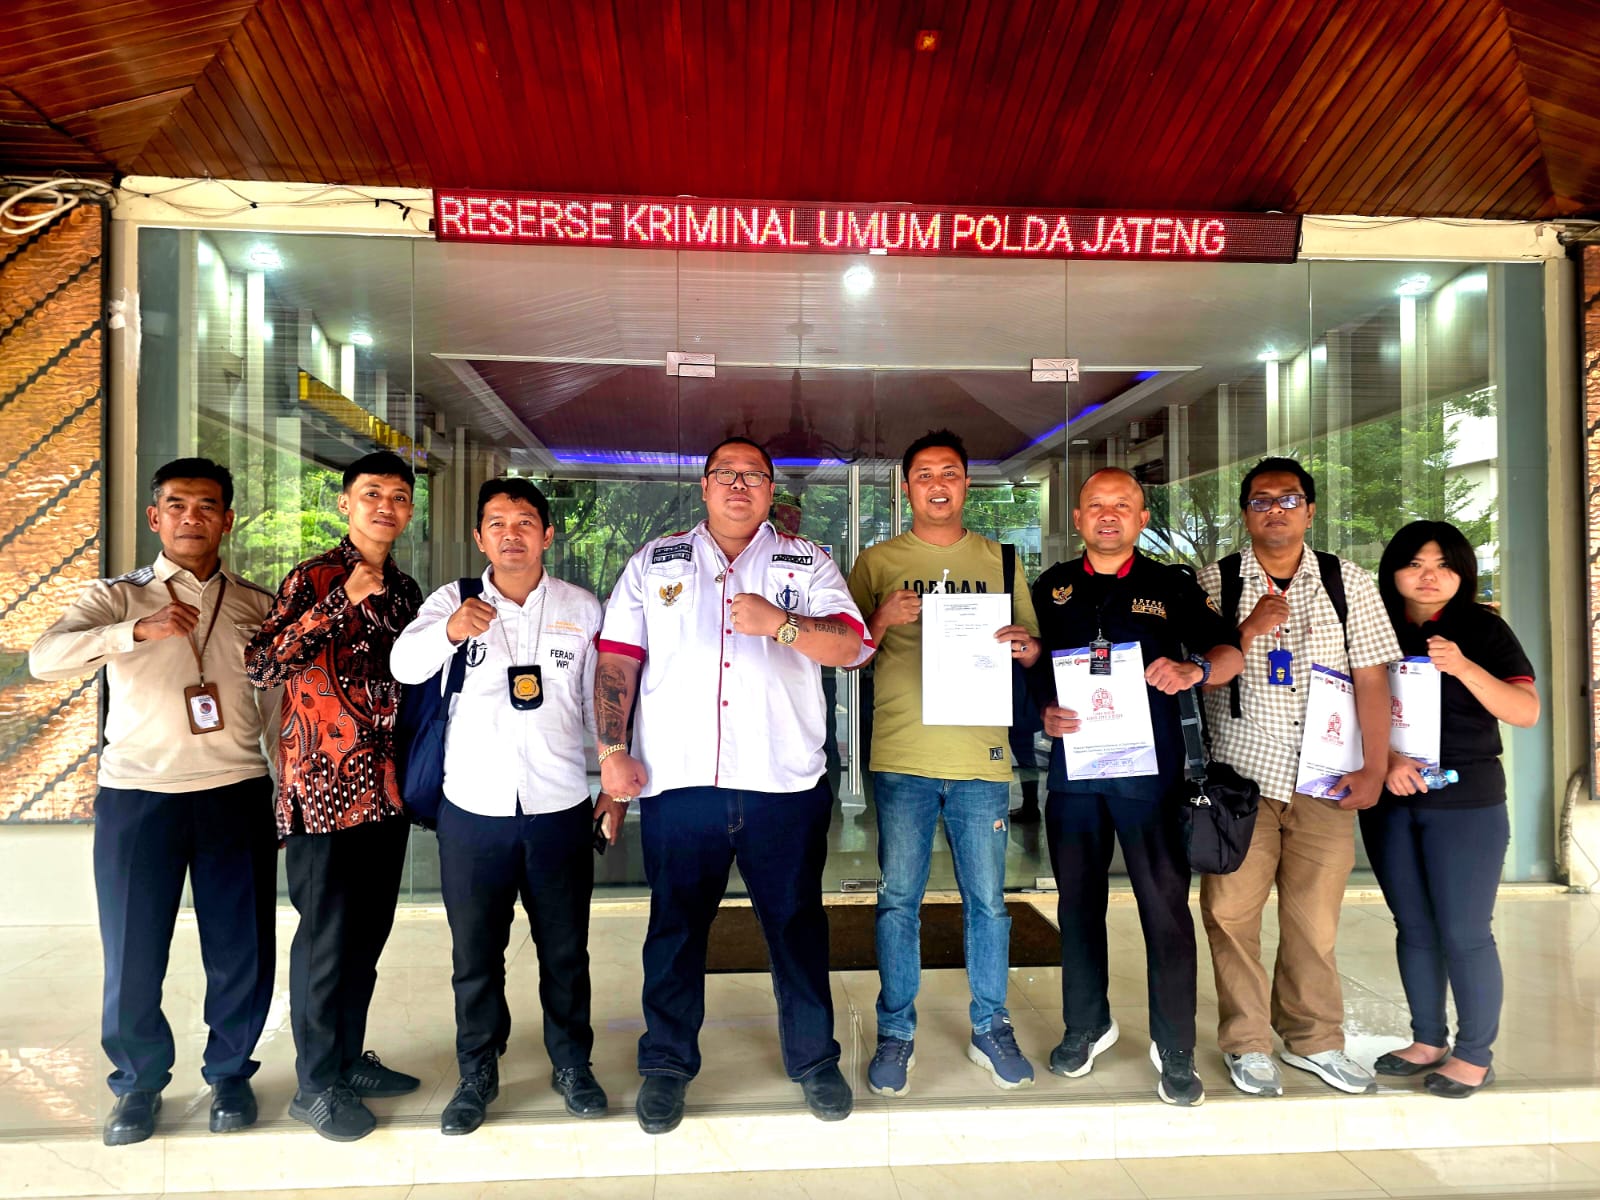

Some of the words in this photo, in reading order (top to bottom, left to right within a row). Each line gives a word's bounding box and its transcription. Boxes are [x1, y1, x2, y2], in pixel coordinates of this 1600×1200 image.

[439, 196, 613, 240] RESERSE
[624, 203, 808, 246] KRIMINAL
[819, 209, 940, 249] UMUM
[952, 213, 1074, 252] POLDA
[1080, 217, 1226, 255] JATENG
[550, 649, 575, 661] FERADI
[556, 659, 570, 669] WPI
